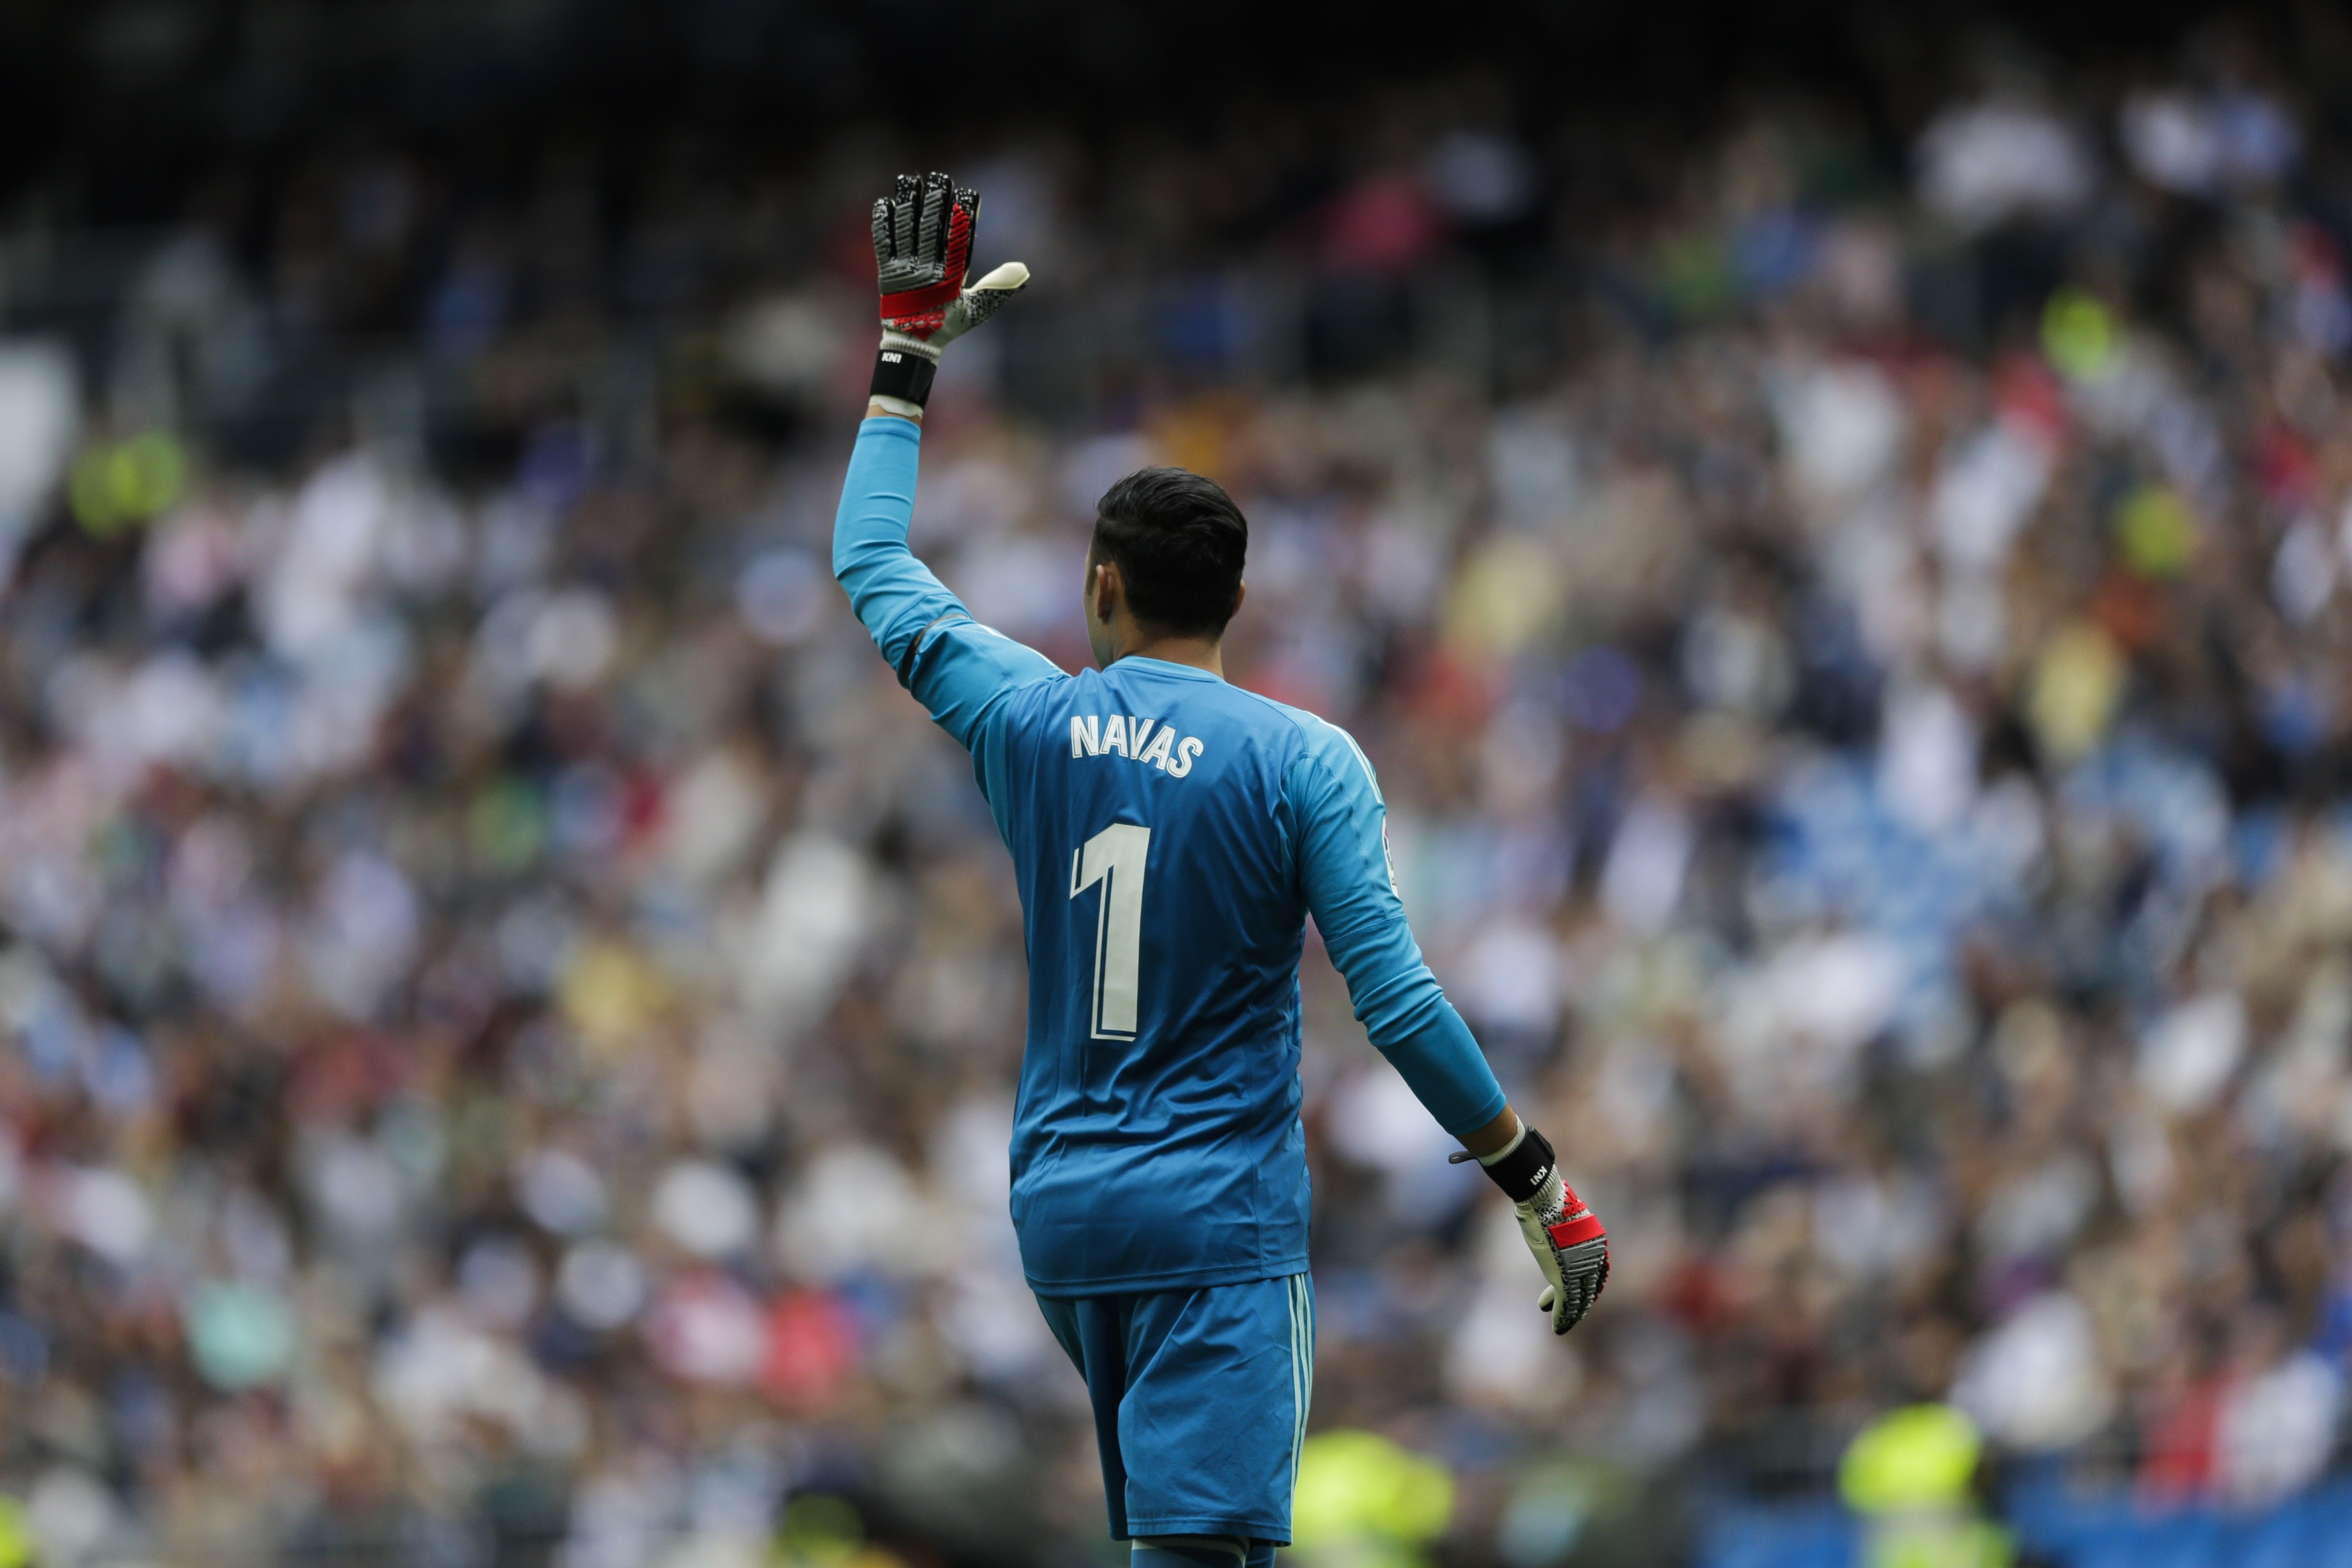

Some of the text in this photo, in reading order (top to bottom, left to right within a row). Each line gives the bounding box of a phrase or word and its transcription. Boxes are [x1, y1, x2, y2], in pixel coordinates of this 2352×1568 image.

[881, 352, 902, 363] KN1
[1071, 714, 1204, 778] NAVAS
[1070, 823, 1151, 1042] 1
[1530, 1165, 1547, 1185] KN1
